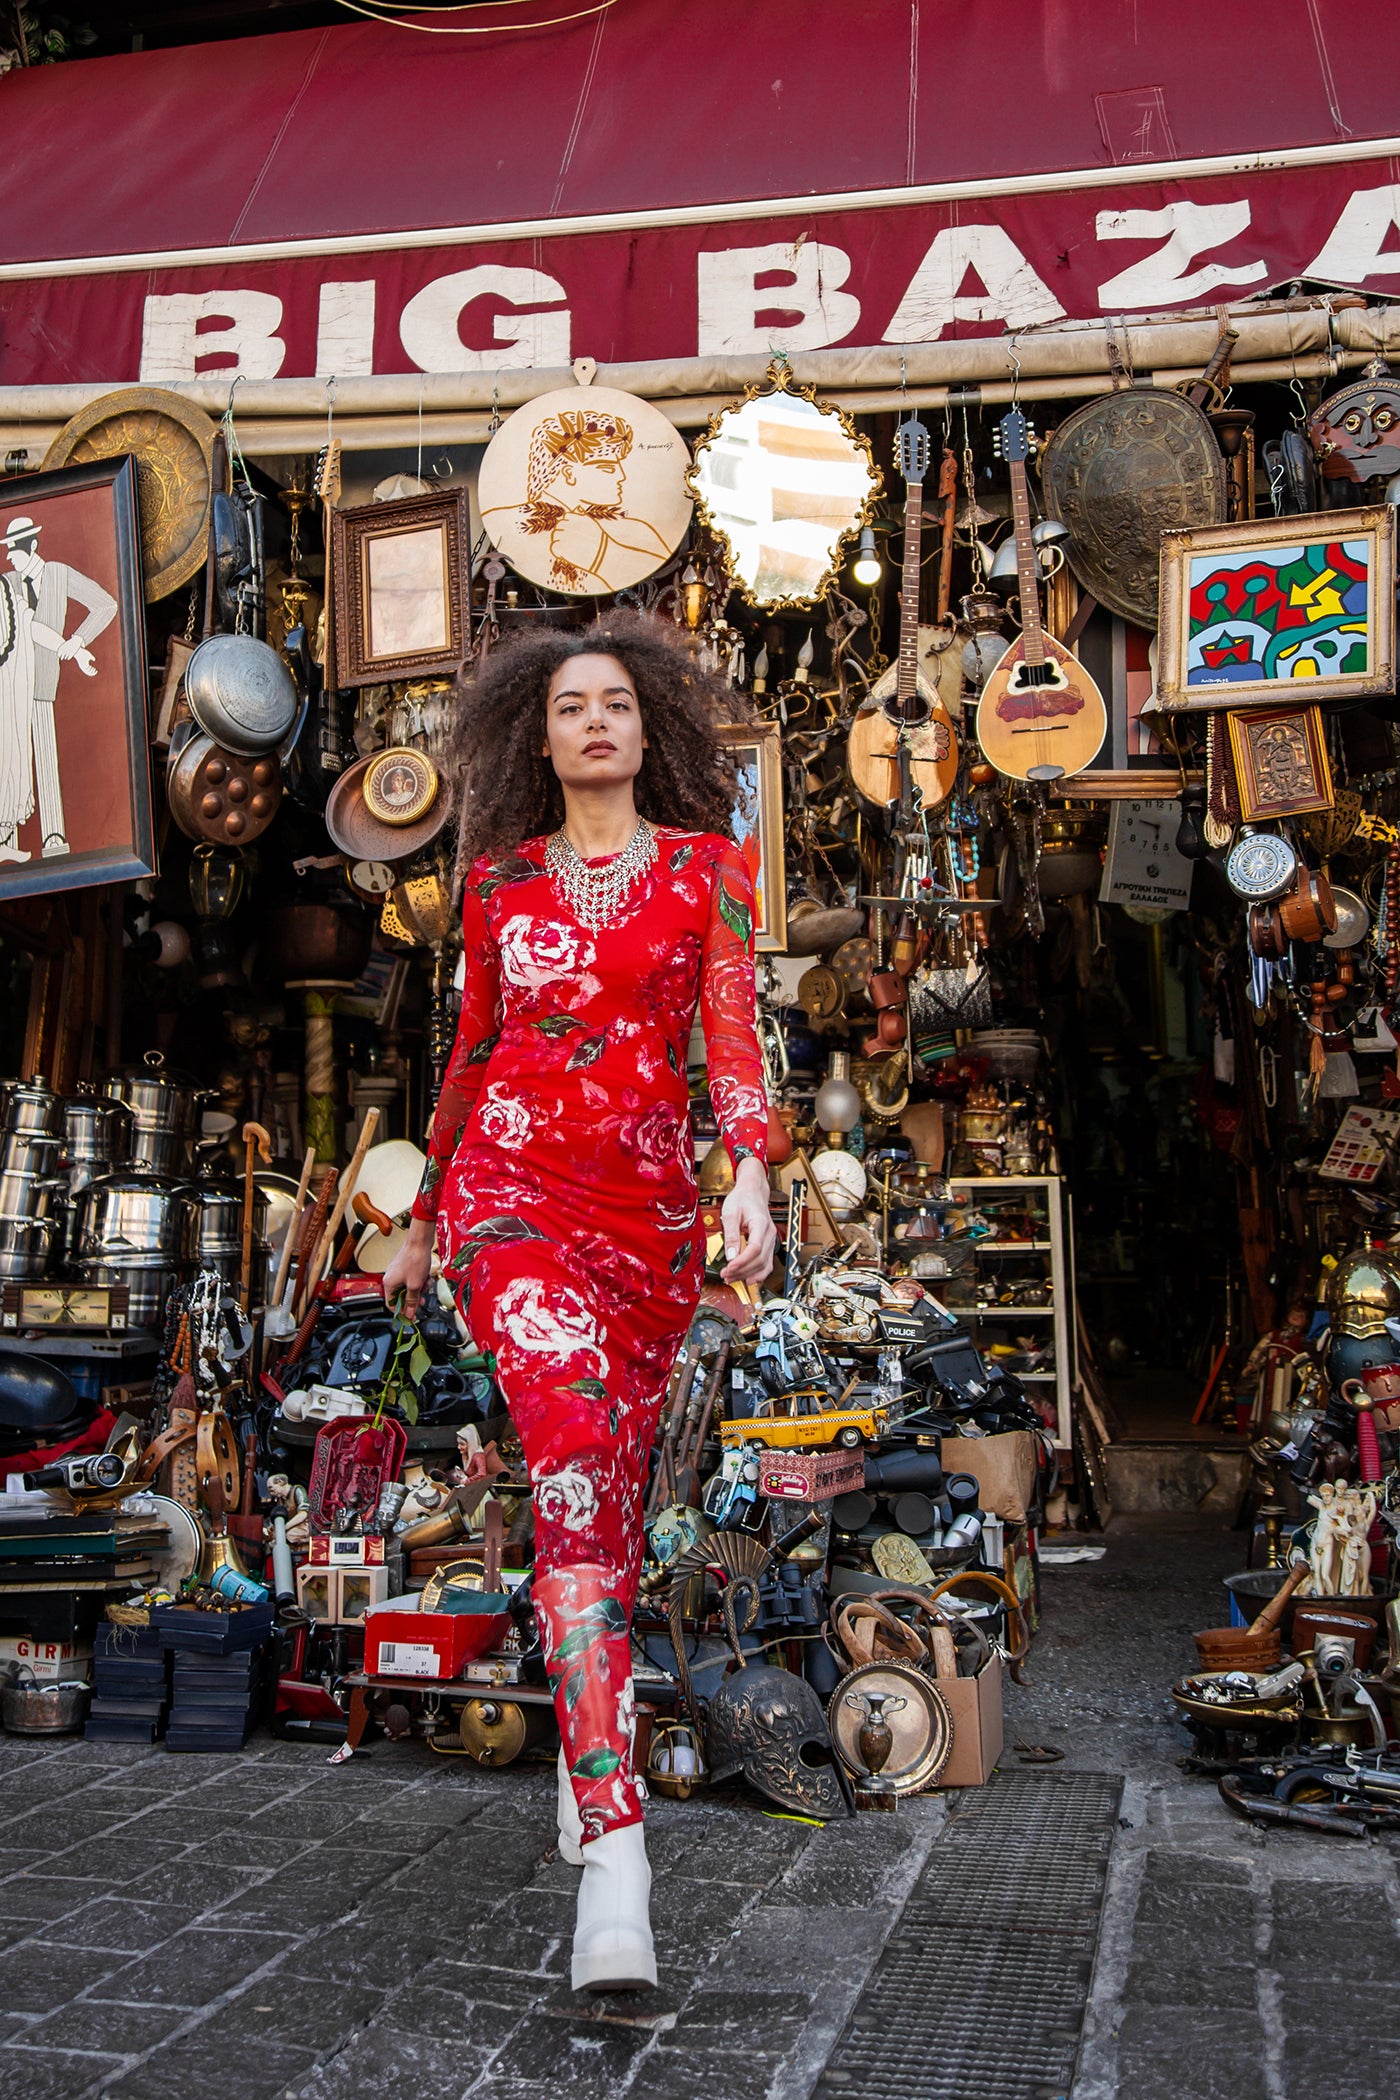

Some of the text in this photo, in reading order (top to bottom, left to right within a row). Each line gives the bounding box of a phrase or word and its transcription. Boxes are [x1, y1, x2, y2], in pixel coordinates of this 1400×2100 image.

[139, 265, 571, 382] BIG
[1131, 803, 1141, 812] 10
[1145, 800, 1152, 808] 11
[1156, 800, 1165, 809] 12
[1127, 818, 1133, 826] 9
[1130, 834, 1136, 842] 8
[1143, 841, 1170, 851] 7 6 5
[1113, 882, 1187, 897] ΑΓΡΟΤΙΚΗ ΤΡΑΠΕΖΑ
[1130, 893, 1168, 904] ΕΛΛΑΔΟΣ
[888, 1327, 916, 1337] POLICE
[17, 1641, 78, 1660] GIRMI
[33, 1664, 52, 1673] Girmi
